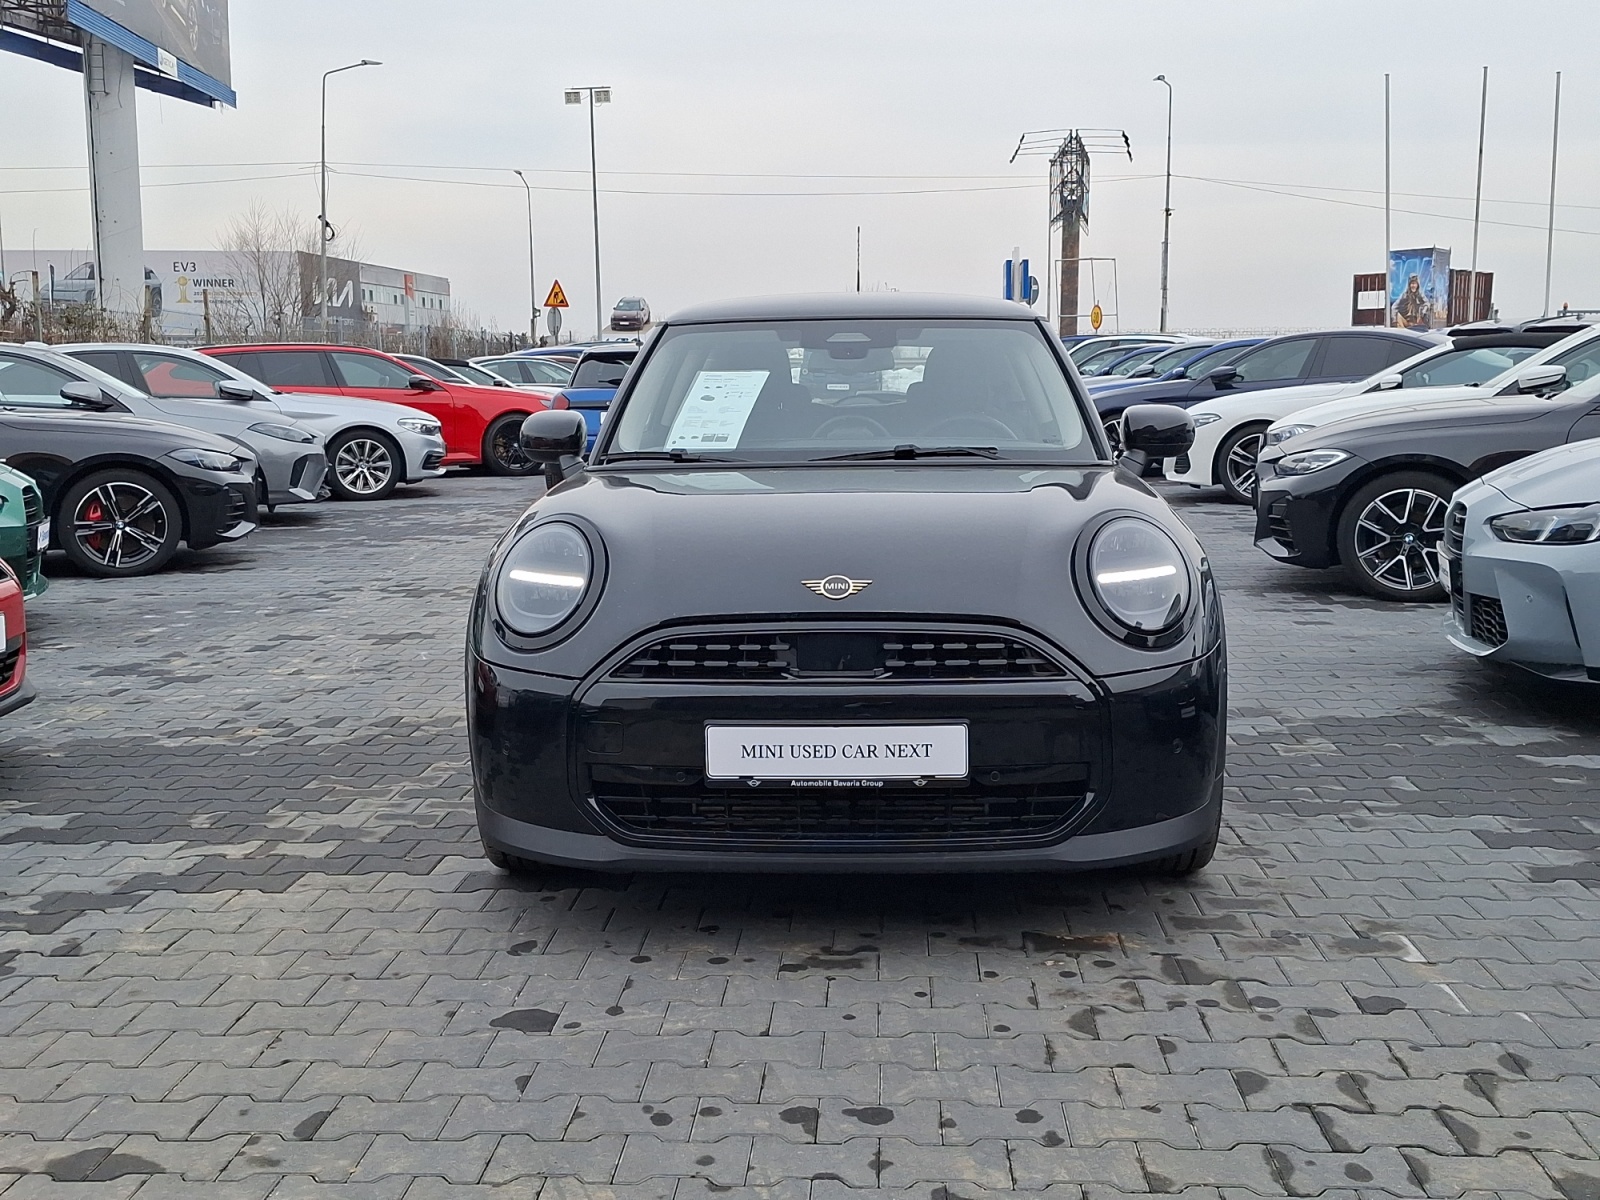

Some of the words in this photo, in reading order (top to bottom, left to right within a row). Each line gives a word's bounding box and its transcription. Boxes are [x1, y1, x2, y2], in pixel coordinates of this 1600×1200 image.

[173, 261, 197, 273] EV3
[192, 278, 235, 288] WINNER
[825, 582, 849, 590] MINI
[741, 744, 785, 759] MINI
[789, 744, 837, 759] USED
[842, 744, 879, 759] CAR
[884, 743, 933, 758] NEXT
[790, 779, 832, 788] Automobile
[833, 779, 860, 787] Bavaria
[861, 779, 884, 788] Group
